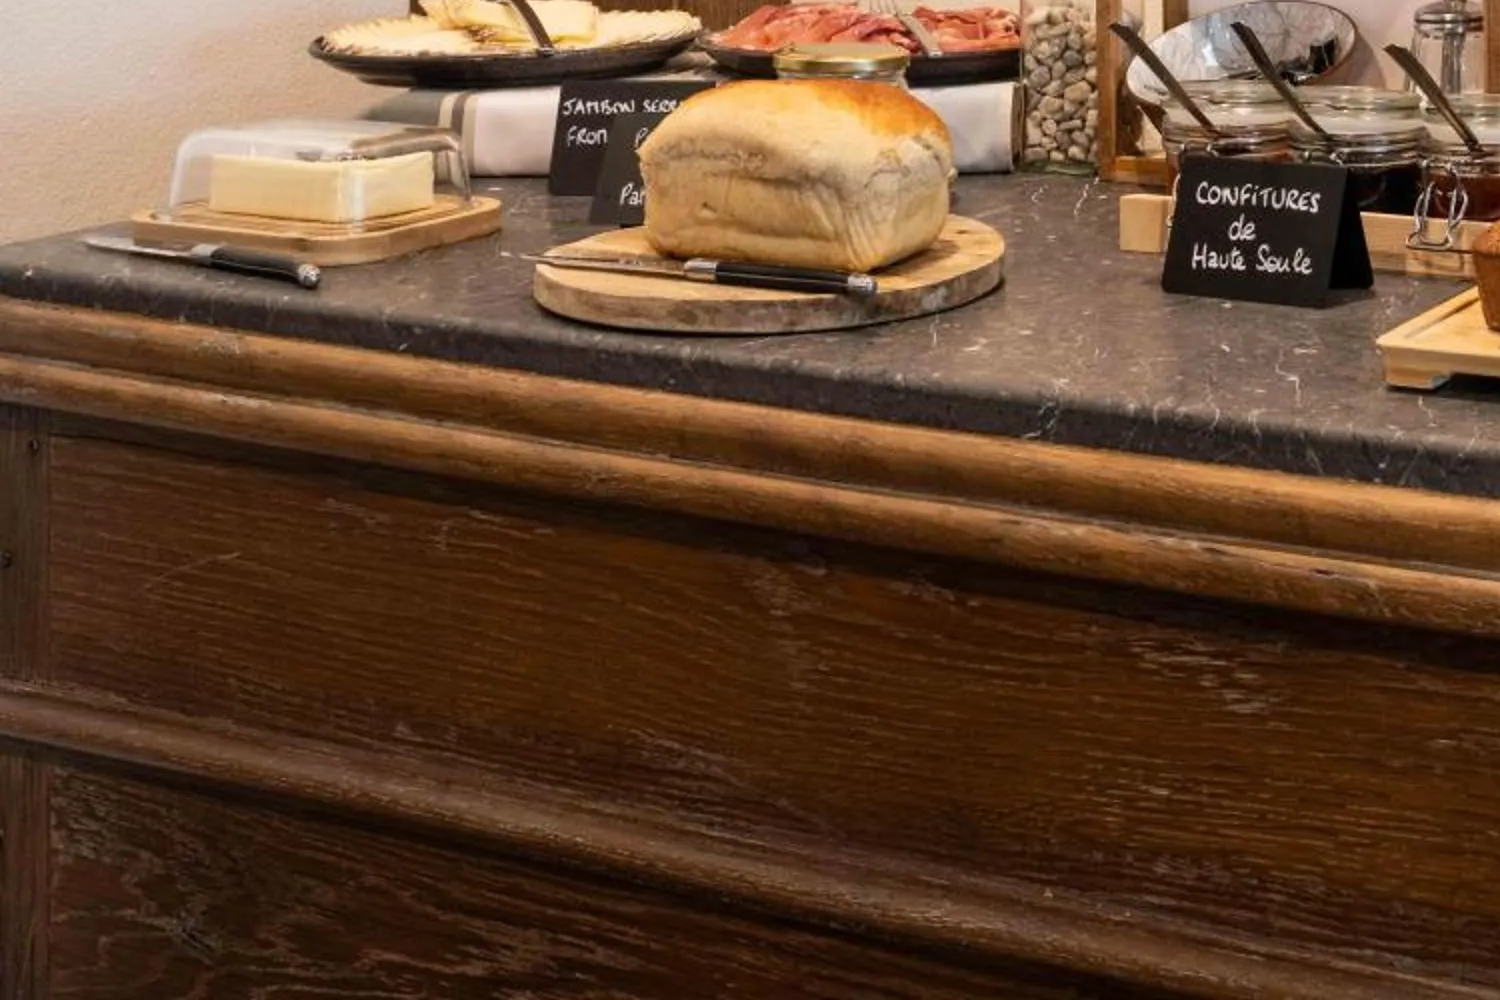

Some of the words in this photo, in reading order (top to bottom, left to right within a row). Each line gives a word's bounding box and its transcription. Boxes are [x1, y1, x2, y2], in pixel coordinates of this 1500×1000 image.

[563, 98, 635, 115] JAMBON
[1227, 213, 1256, 241] de
[1191, 243, 1246, 270] Haute
[1255, 244, 1313, 275] Soule
